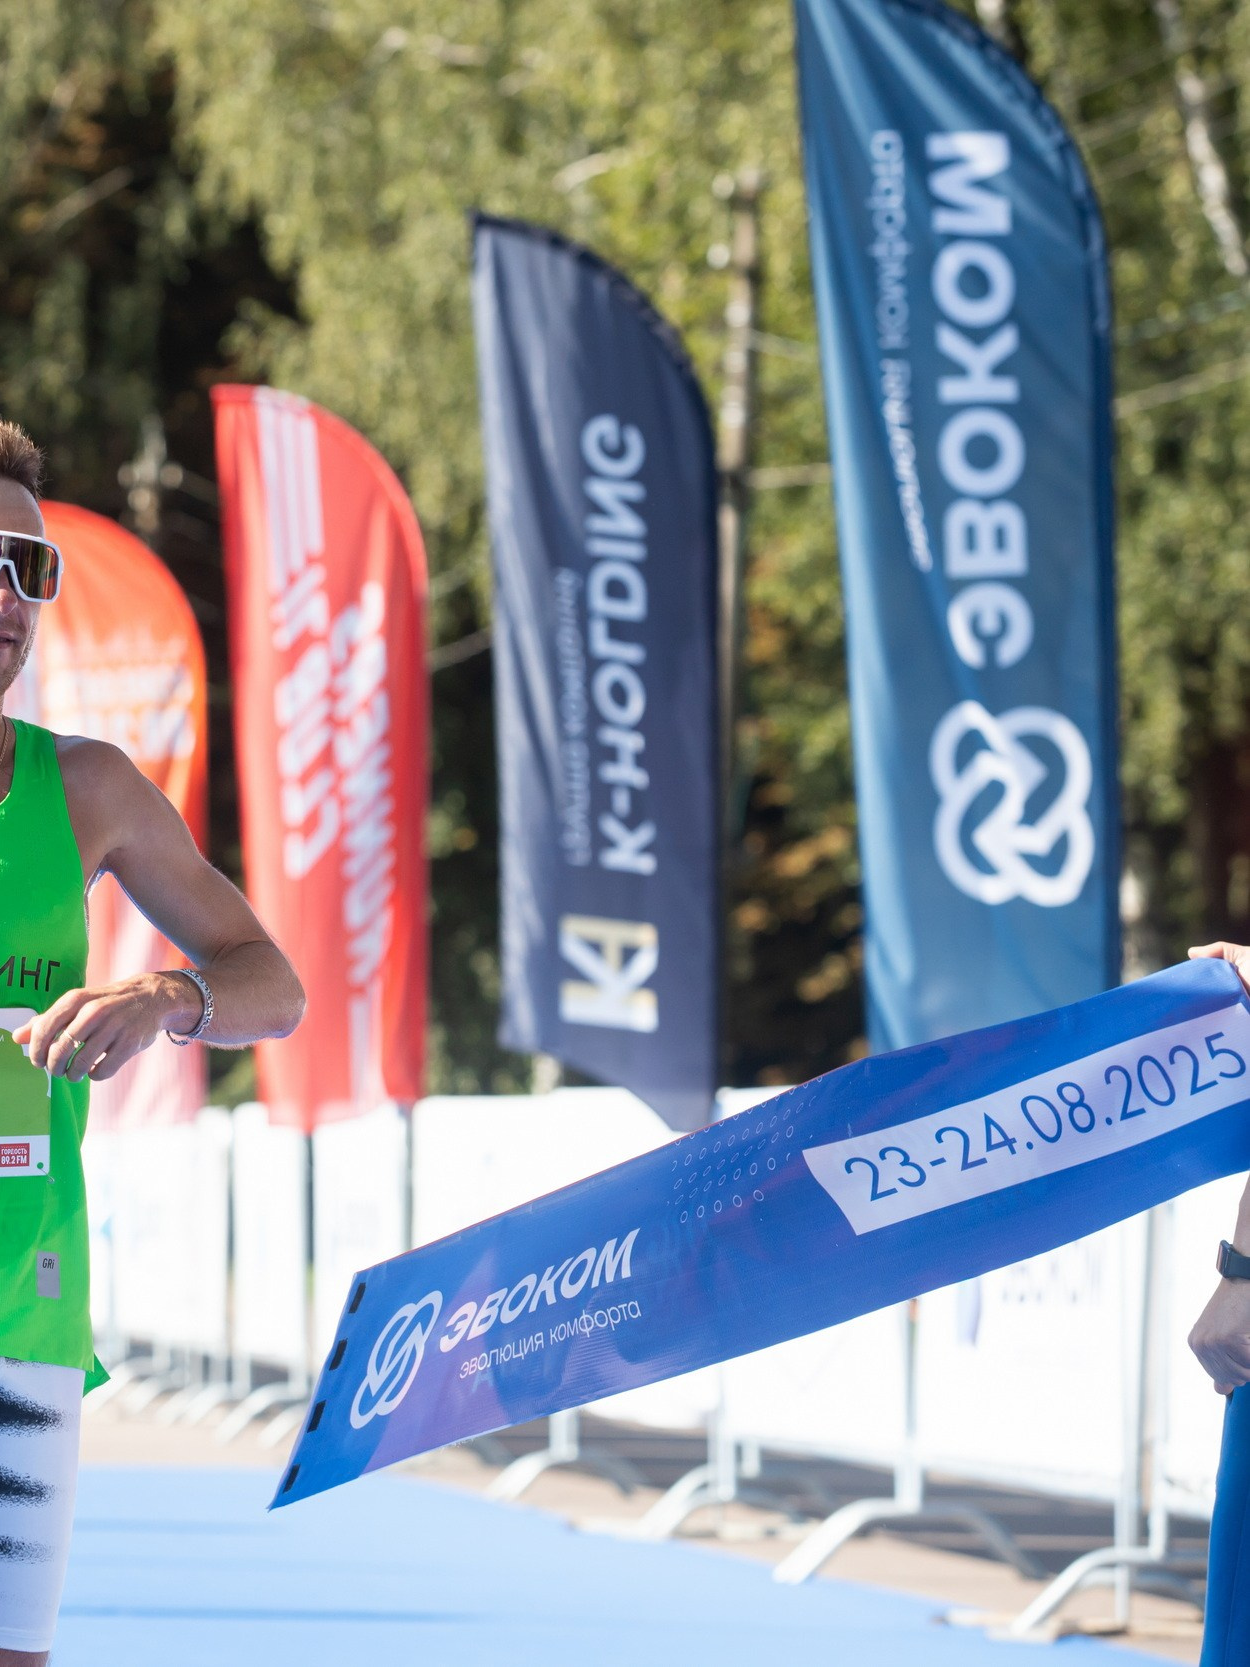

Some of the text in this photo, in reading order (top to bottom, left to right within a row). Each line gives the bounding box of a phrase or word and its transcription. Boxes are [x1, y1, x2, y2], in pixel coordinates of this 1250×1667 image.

[1, 1155, 27, 1165] 89.2 FM
[844, 1031, 1247, 1202] 23-24.08.2025
[439, 1227, 641, 1353] ЭВОКОМ
[459, 1331, 545, 1380] эволюция
[549, 1299, 642, 1338] комфорта
